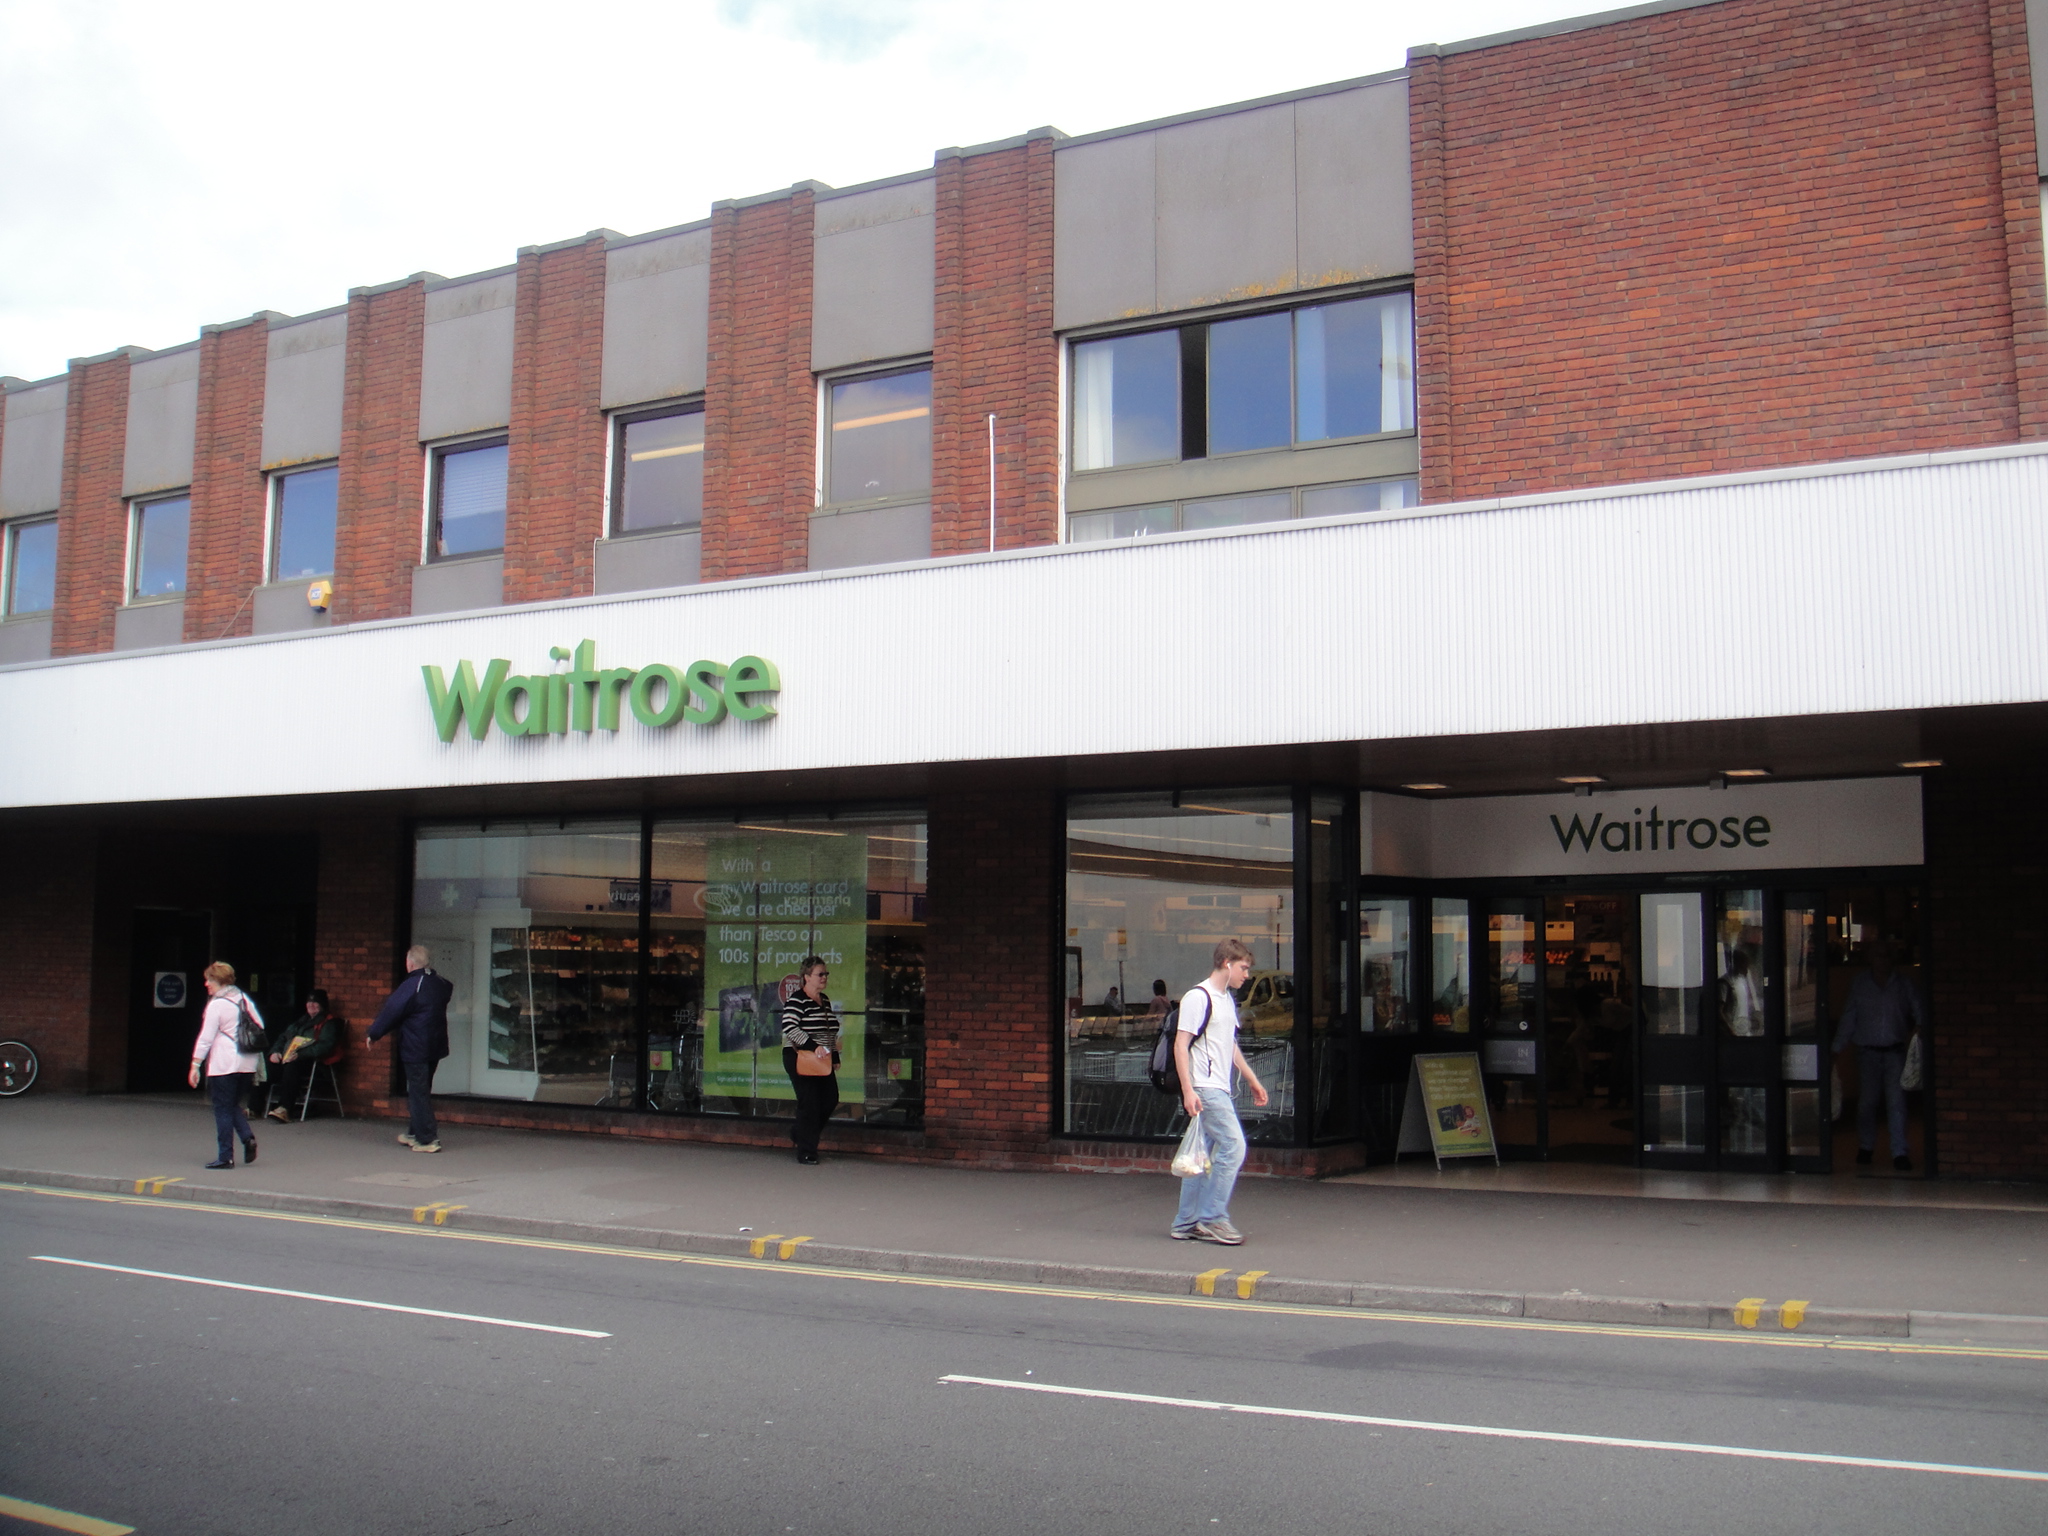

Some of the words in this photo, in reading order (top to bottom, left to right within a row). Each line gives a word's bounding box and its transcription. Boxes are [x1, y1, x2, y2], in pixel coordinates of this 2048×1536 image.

[421, 638, 781, 743] Waitrose
[1549, 804, 1771, 854] Waitrose
[721, 858, 754, 873] With
[761, 861, 771, 872] a
[815, 880, 849, 894] card
[721, 905, 740, 917] we
[746, 904, 773, 916] are
[776, 902, 837, 921] cheaper
[719, 925, 752, 942] than
[759, 927, 797, 942] Tesco
[800, 930, 823, 942] on
[719, 948, 750, 964] 100s
[757, 947, 774, 964] of
